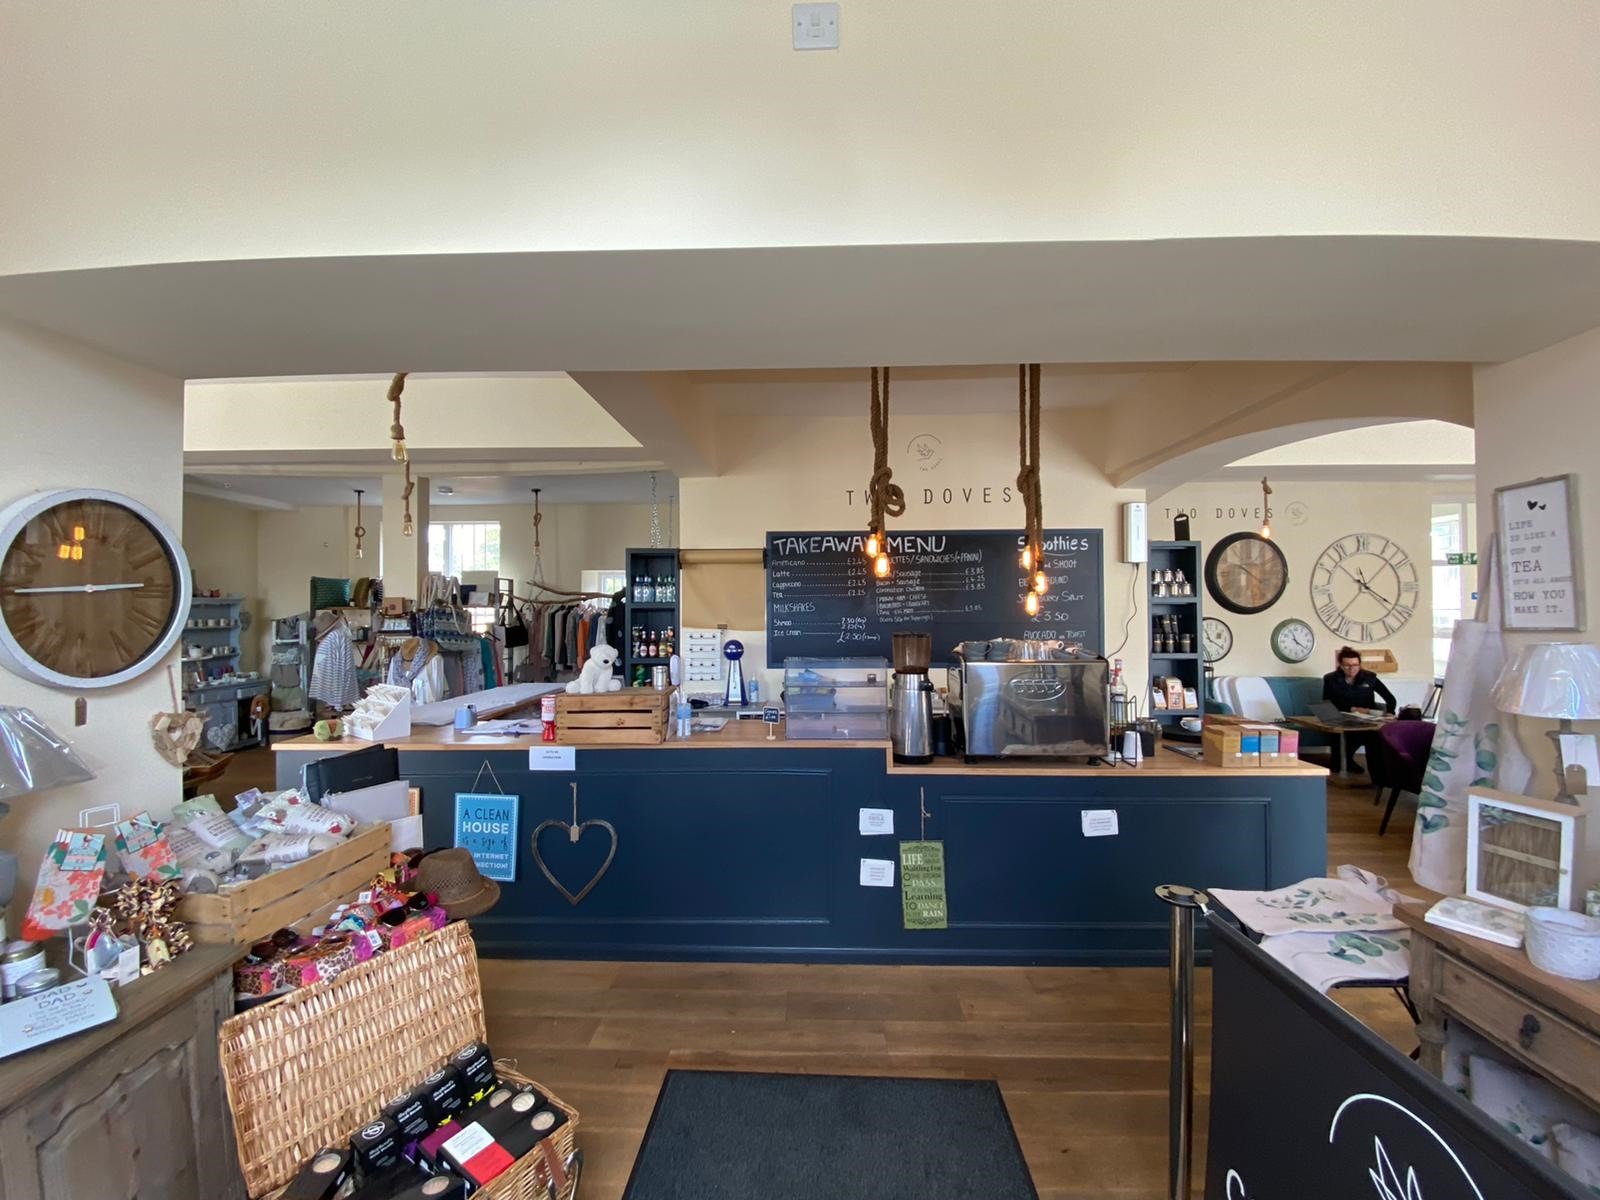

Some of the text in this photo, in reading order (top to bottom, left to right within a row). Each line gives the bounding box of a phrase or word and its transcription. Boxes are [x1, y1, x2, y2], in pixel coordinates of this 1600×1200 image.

[924, 487, 1011, 504] DOVES
[1217, 507, 1273, 519] DOVES
[773, 536, 946, 556] TAKEAWA MENU
[1512, 559, 1542, 573] TEA
[1542, 588, 1566, 599] YOU
[773, 601, 816, 614] MILKSHAKES
[463, 807, 510, 822] A CLEAN
[462, 821, 510, 835] HOUSE
[473, 852, 509, 860] INTERNET
[902, 853, 924, 866] LIFE
[912, 879, 937, 888] PASS
[904, 890, 944, 902] Learning
[922, 909, 944, 919] RAIN
